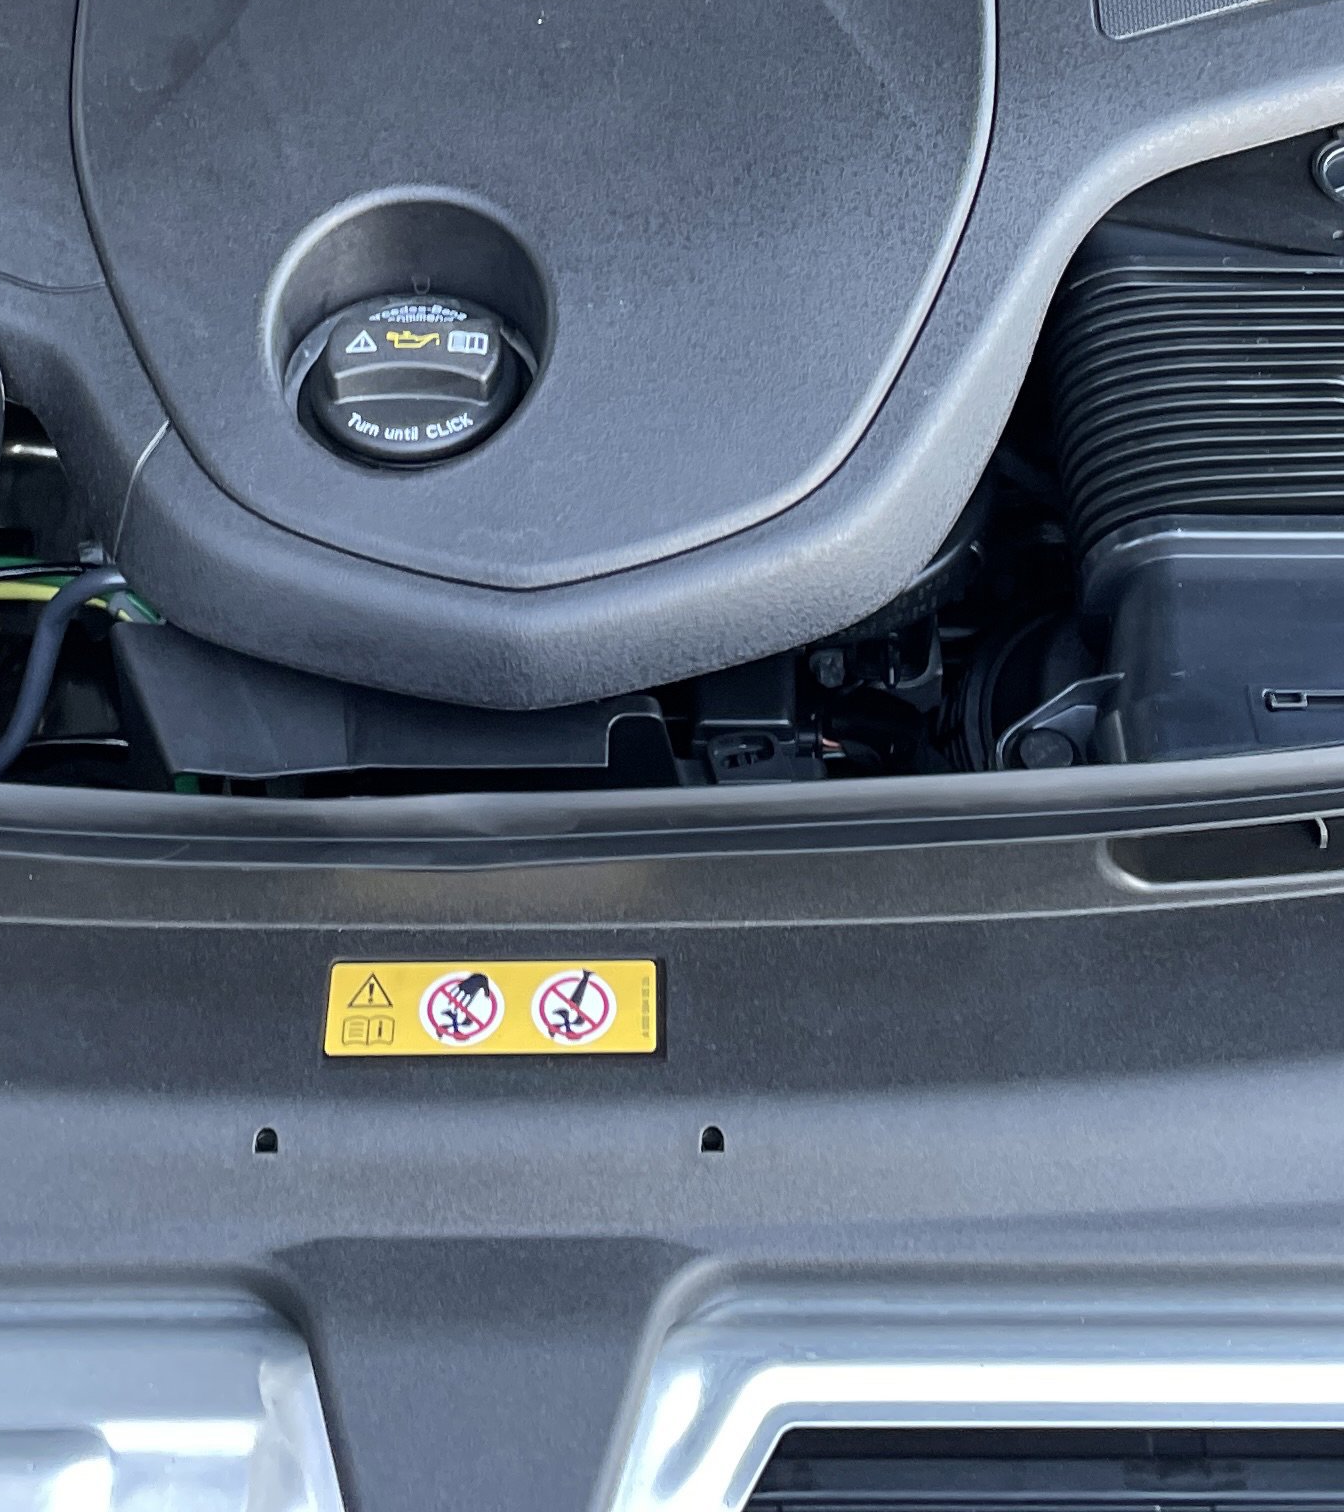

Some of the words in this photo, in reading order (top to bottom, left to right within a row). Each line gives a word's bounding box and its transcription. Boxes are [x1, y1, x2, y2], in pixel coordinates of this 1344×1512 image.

[347, 411, 380, 437] Turn
[384, 425, 419, 441] until
[425, 412, 474, 439] CLICK
